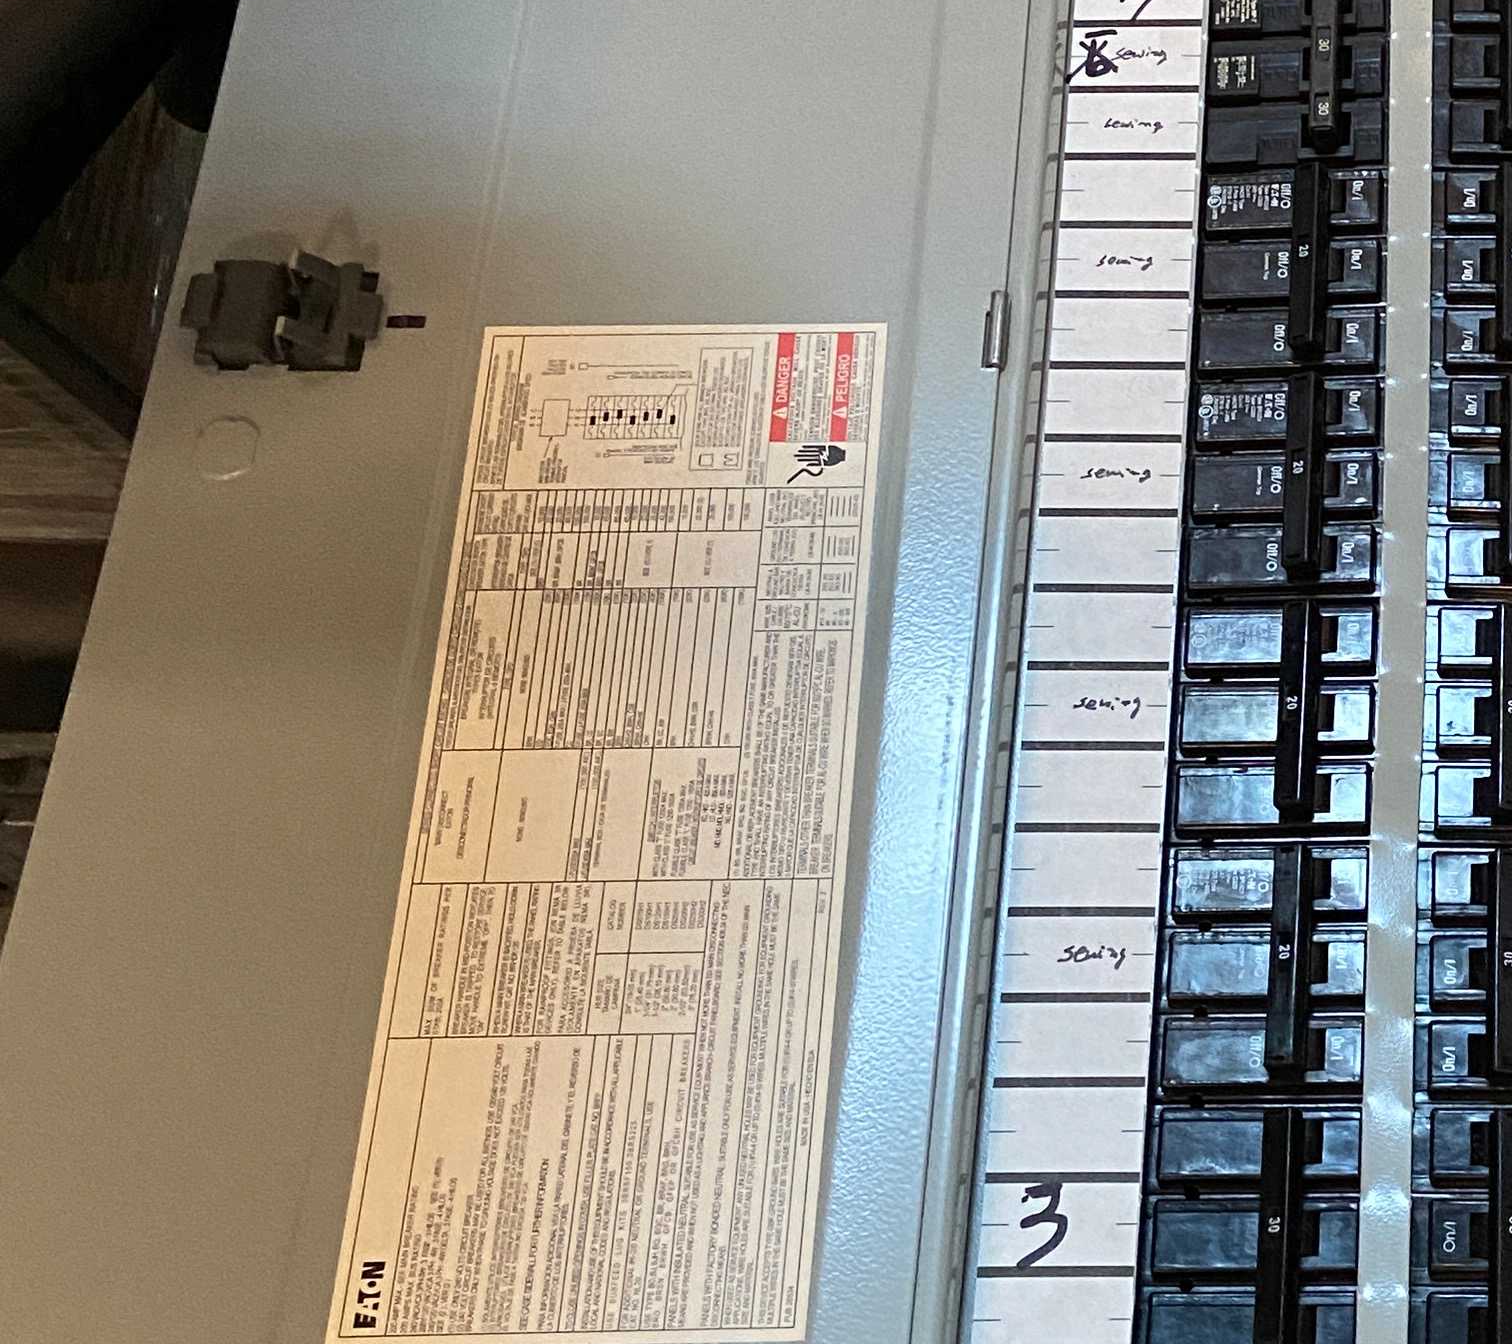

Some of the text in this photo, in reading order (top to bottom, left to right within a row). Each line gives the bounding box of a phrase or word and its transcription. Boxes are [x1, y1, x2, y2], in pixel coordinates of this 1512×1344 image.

[1319, 37, 1331, 53] 30
[1318, 101, 1330, 117] 30
[1463, 188, 1476, 208] On/I
[1461, 259, 1474, 281] On/I
[1346, 322, 1358, 344] On/I
[775, 356, 791, 402] DANGER
[834, 353, 850, 402] PELIGRO
[1350, 389, 1361, 413] On/I
[1465, 393, 1478, 417] On/I
[1293, 460, 1304, 474] 20
[1346, 462, 1359, 486] On/I
[1286, 695, 1299, 711] 20
[1278, 943, 1291, 960] 20
[1442, 957, 1457, 986] On/I
[1442, 1044, 1457, 1074] On/I
[1016, 1182, 1069, 1271] 3
[1267, 1216, 1281, 1235] 30
[1442, 1220, 1457, 1254] On/I
[352, 1260, 386, 1328] EATON
